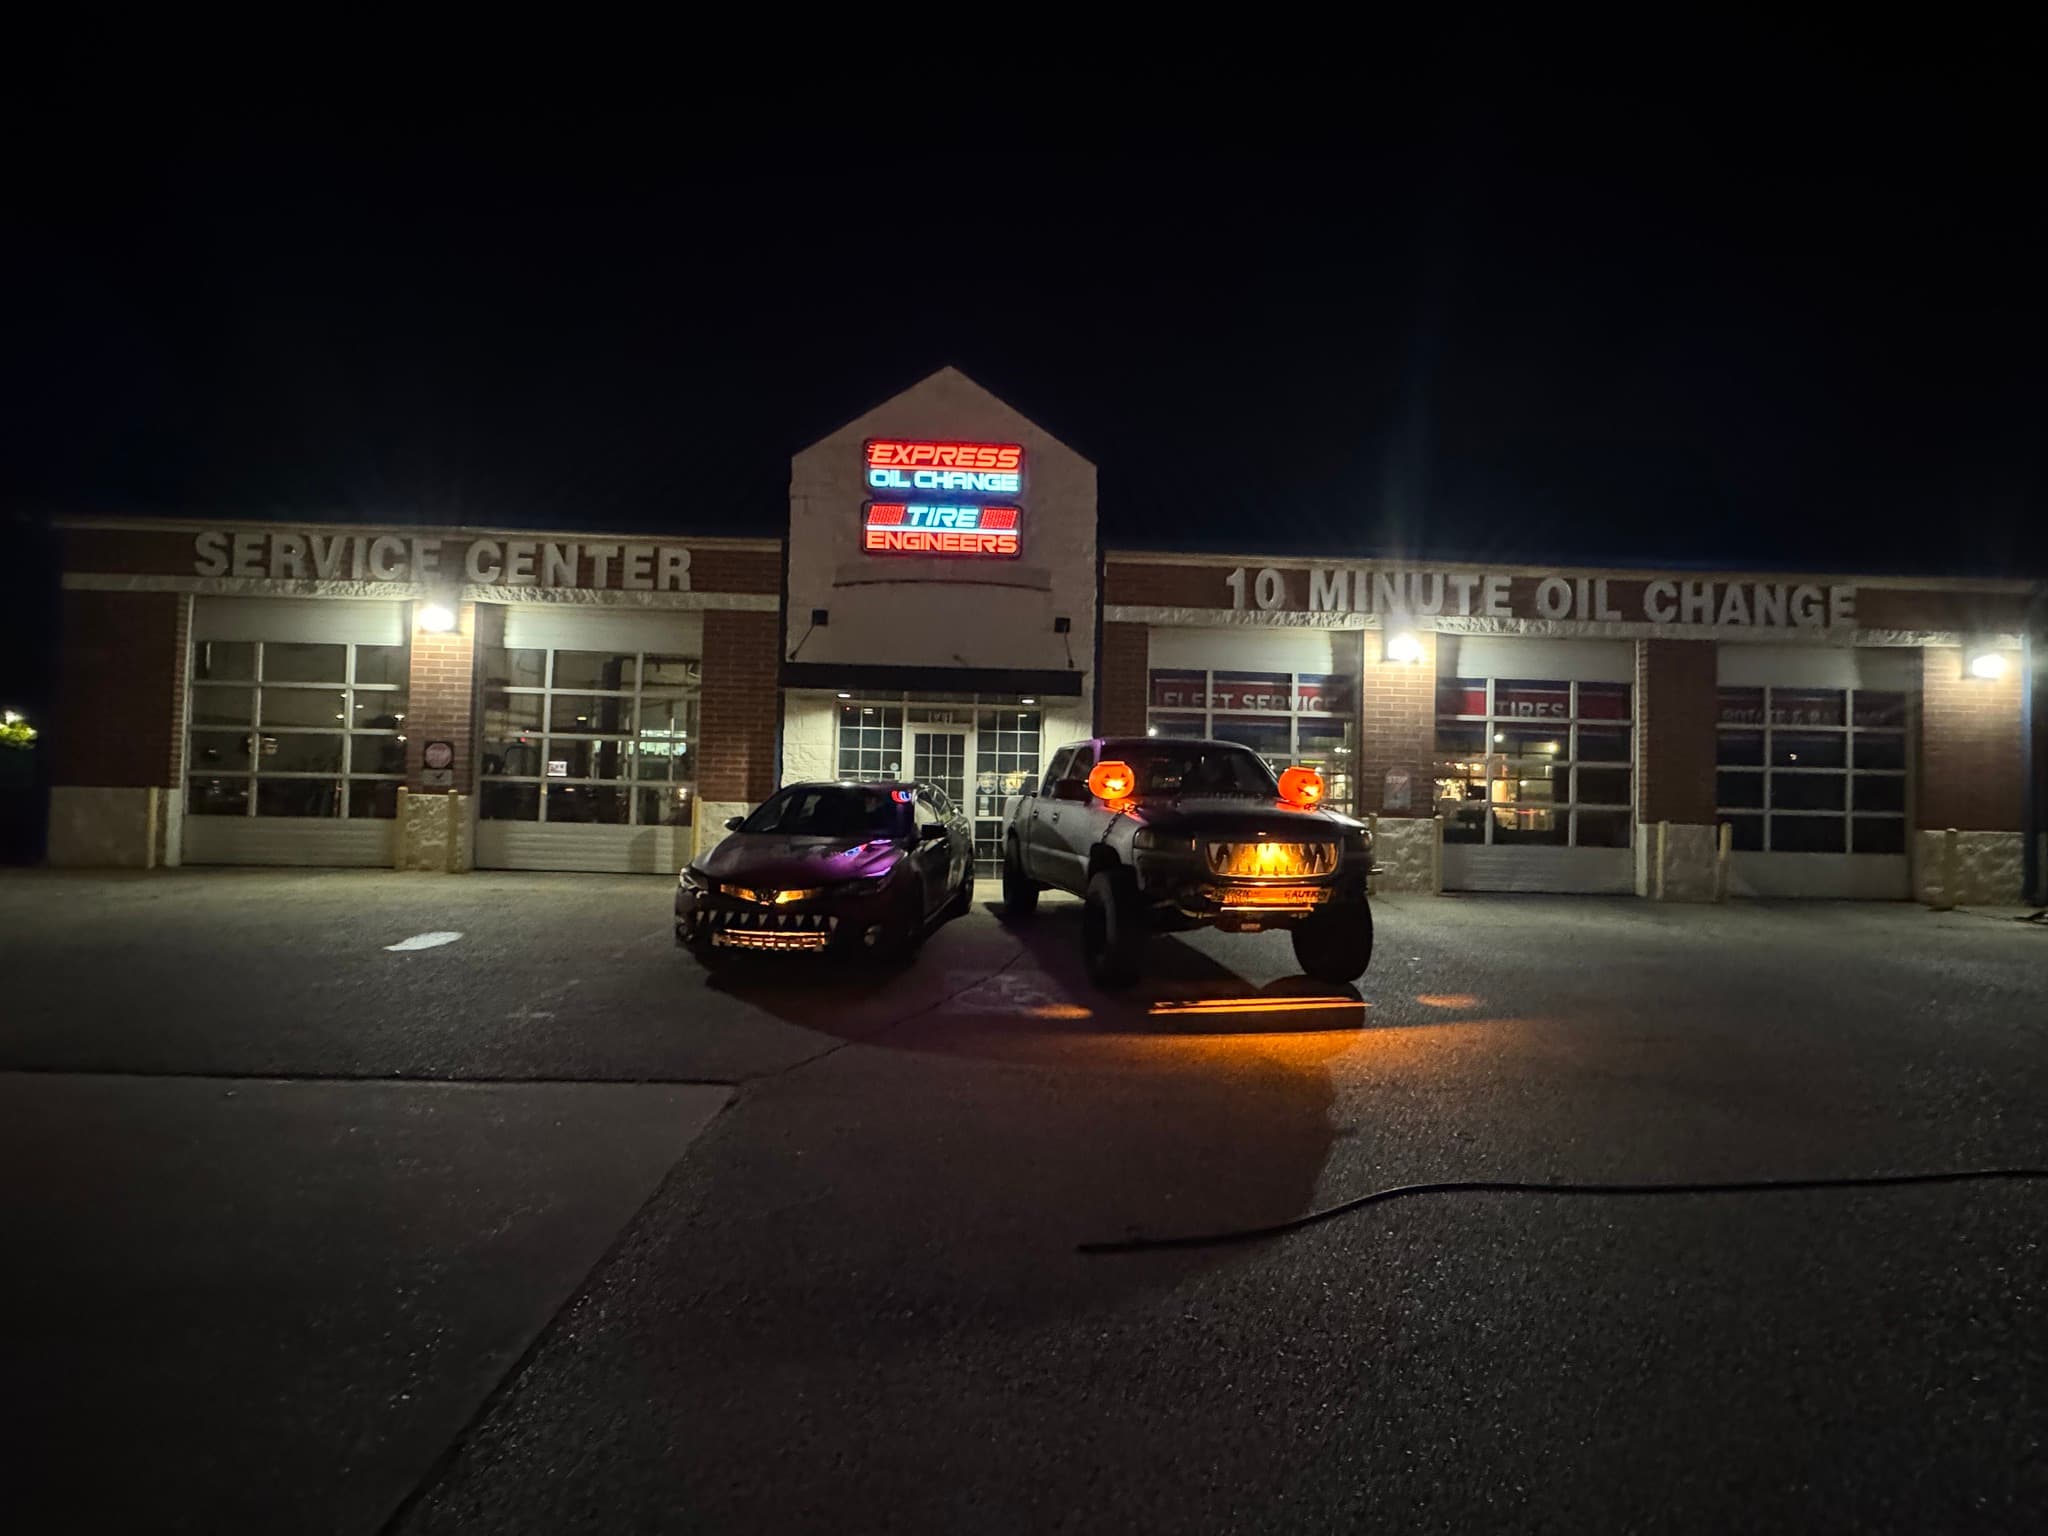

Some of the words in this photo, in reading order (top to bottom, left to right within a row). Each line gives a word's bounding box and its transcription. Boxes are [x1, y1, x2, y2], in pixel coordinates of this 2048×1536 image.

[869, 443, 1021, 468] EXPRESS
[869, 469, 911, 488] OIL
[914, 470, 1019, 492] CHANGE
[907, 506, 979, 528] TIRE
[866, 531, 1017, 554] ENGINEERS
[194, 531, 439, 583] SERVICE
[465, 538, 692, 591] CENTER
[1225, 567, 1286, 610] 10
[1308, 568, 1513, 617] MINUTE
[1535, 576, 1622, 621] OIL
[1643, 580, 1857, 629] CHANGE
